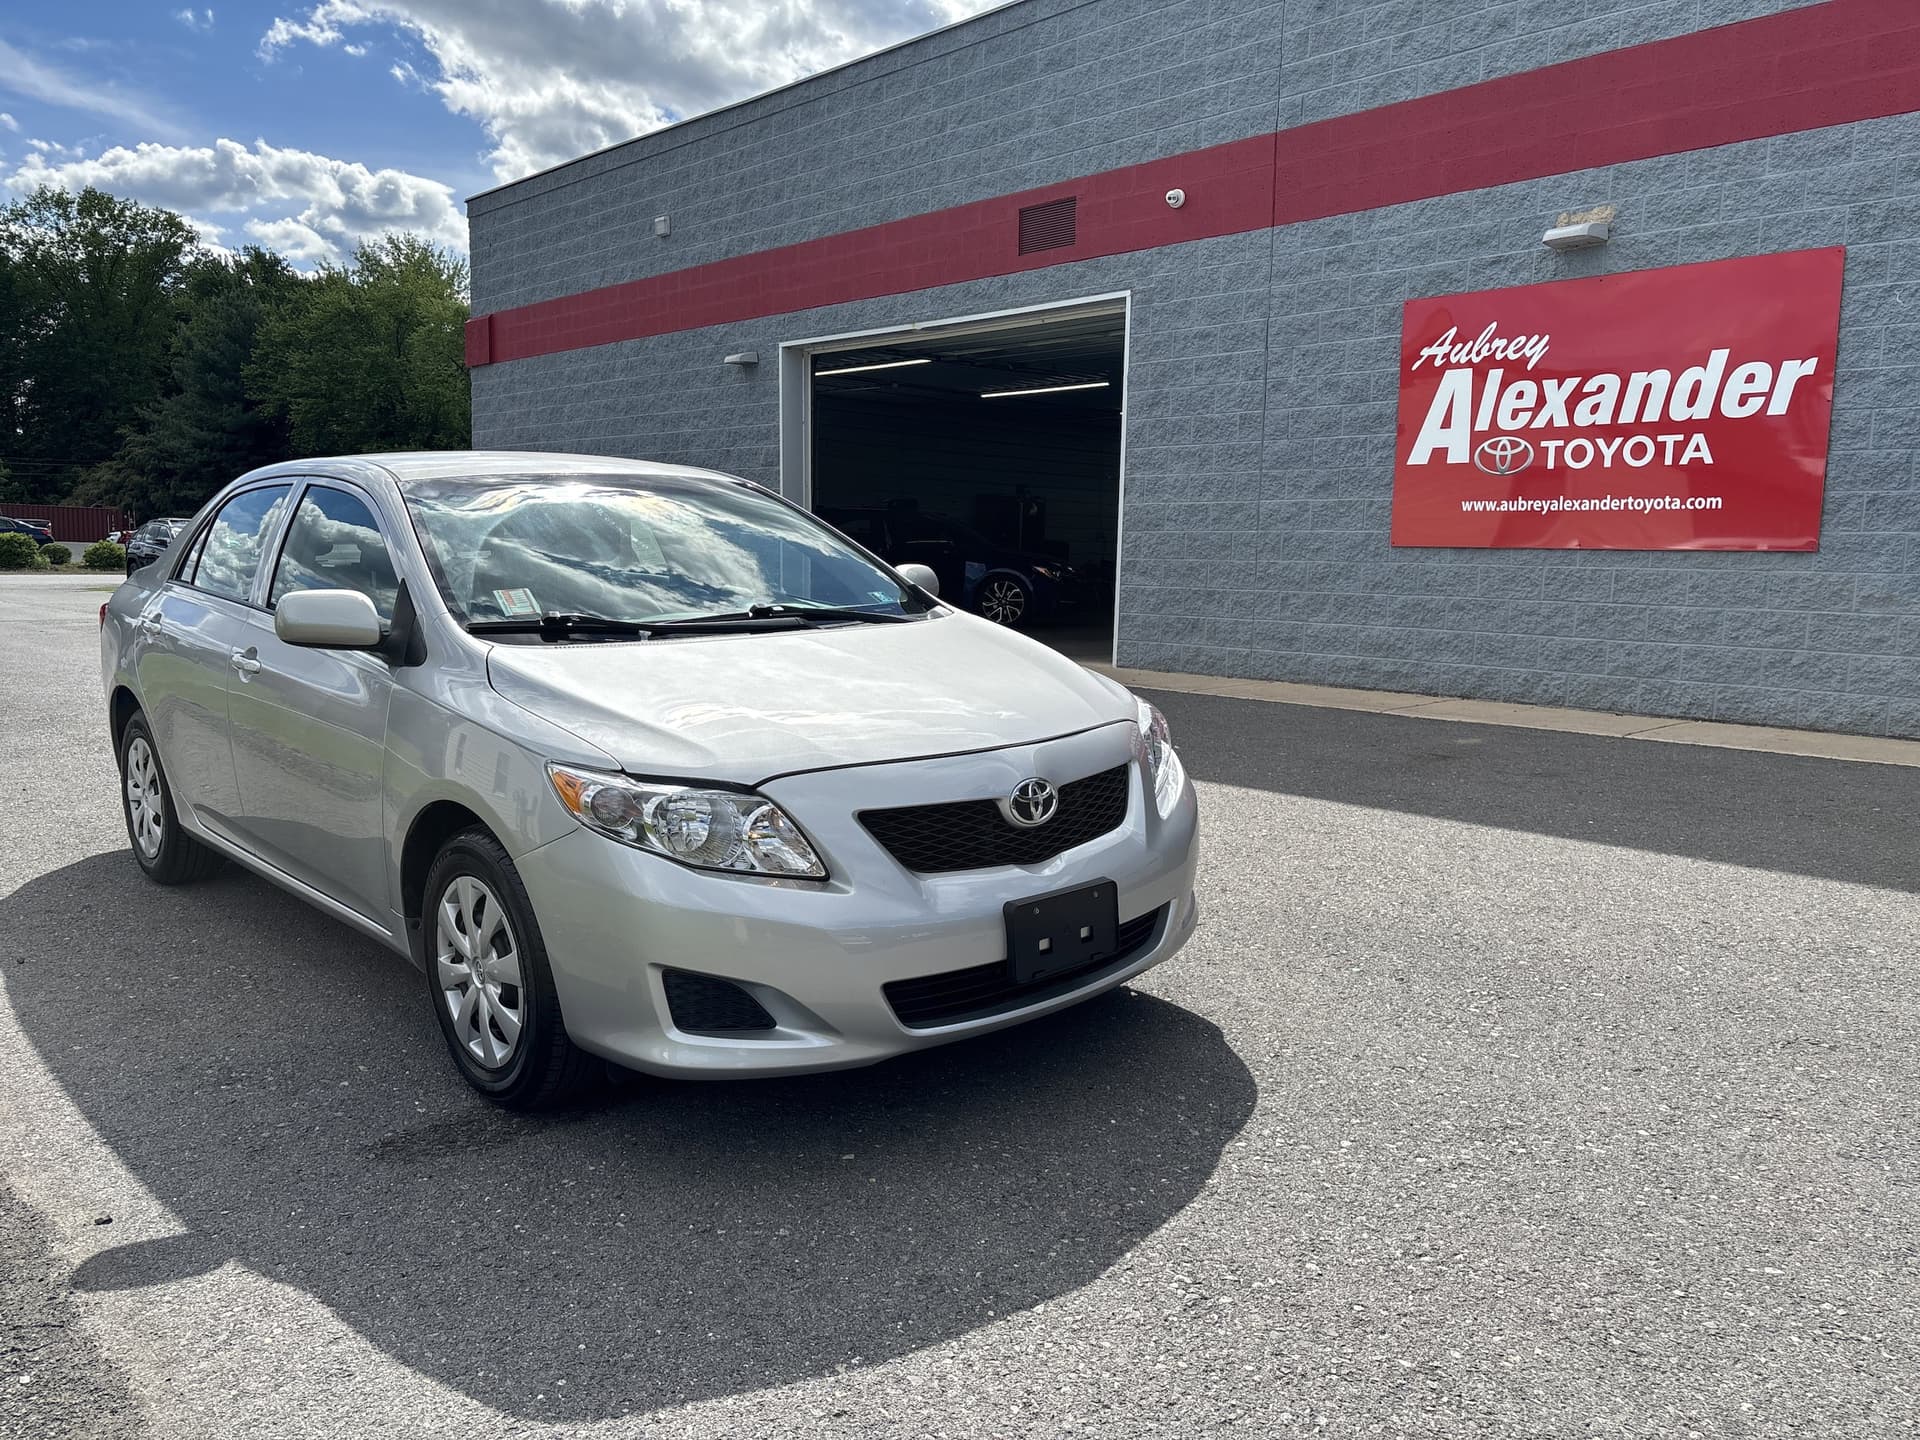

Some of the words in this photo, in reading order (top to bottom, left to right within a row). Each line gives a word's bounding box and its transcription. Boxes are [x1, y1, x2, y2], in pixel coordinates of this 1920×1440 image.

[1412, 321, 1550, 371] Aubrey
[1407, 349, 1818, 465] Alexander
[1540, 433, 1713, 469] TOYOTA
[1461, 495, 1722, 515] www.aubreyalexandertoyota.com
